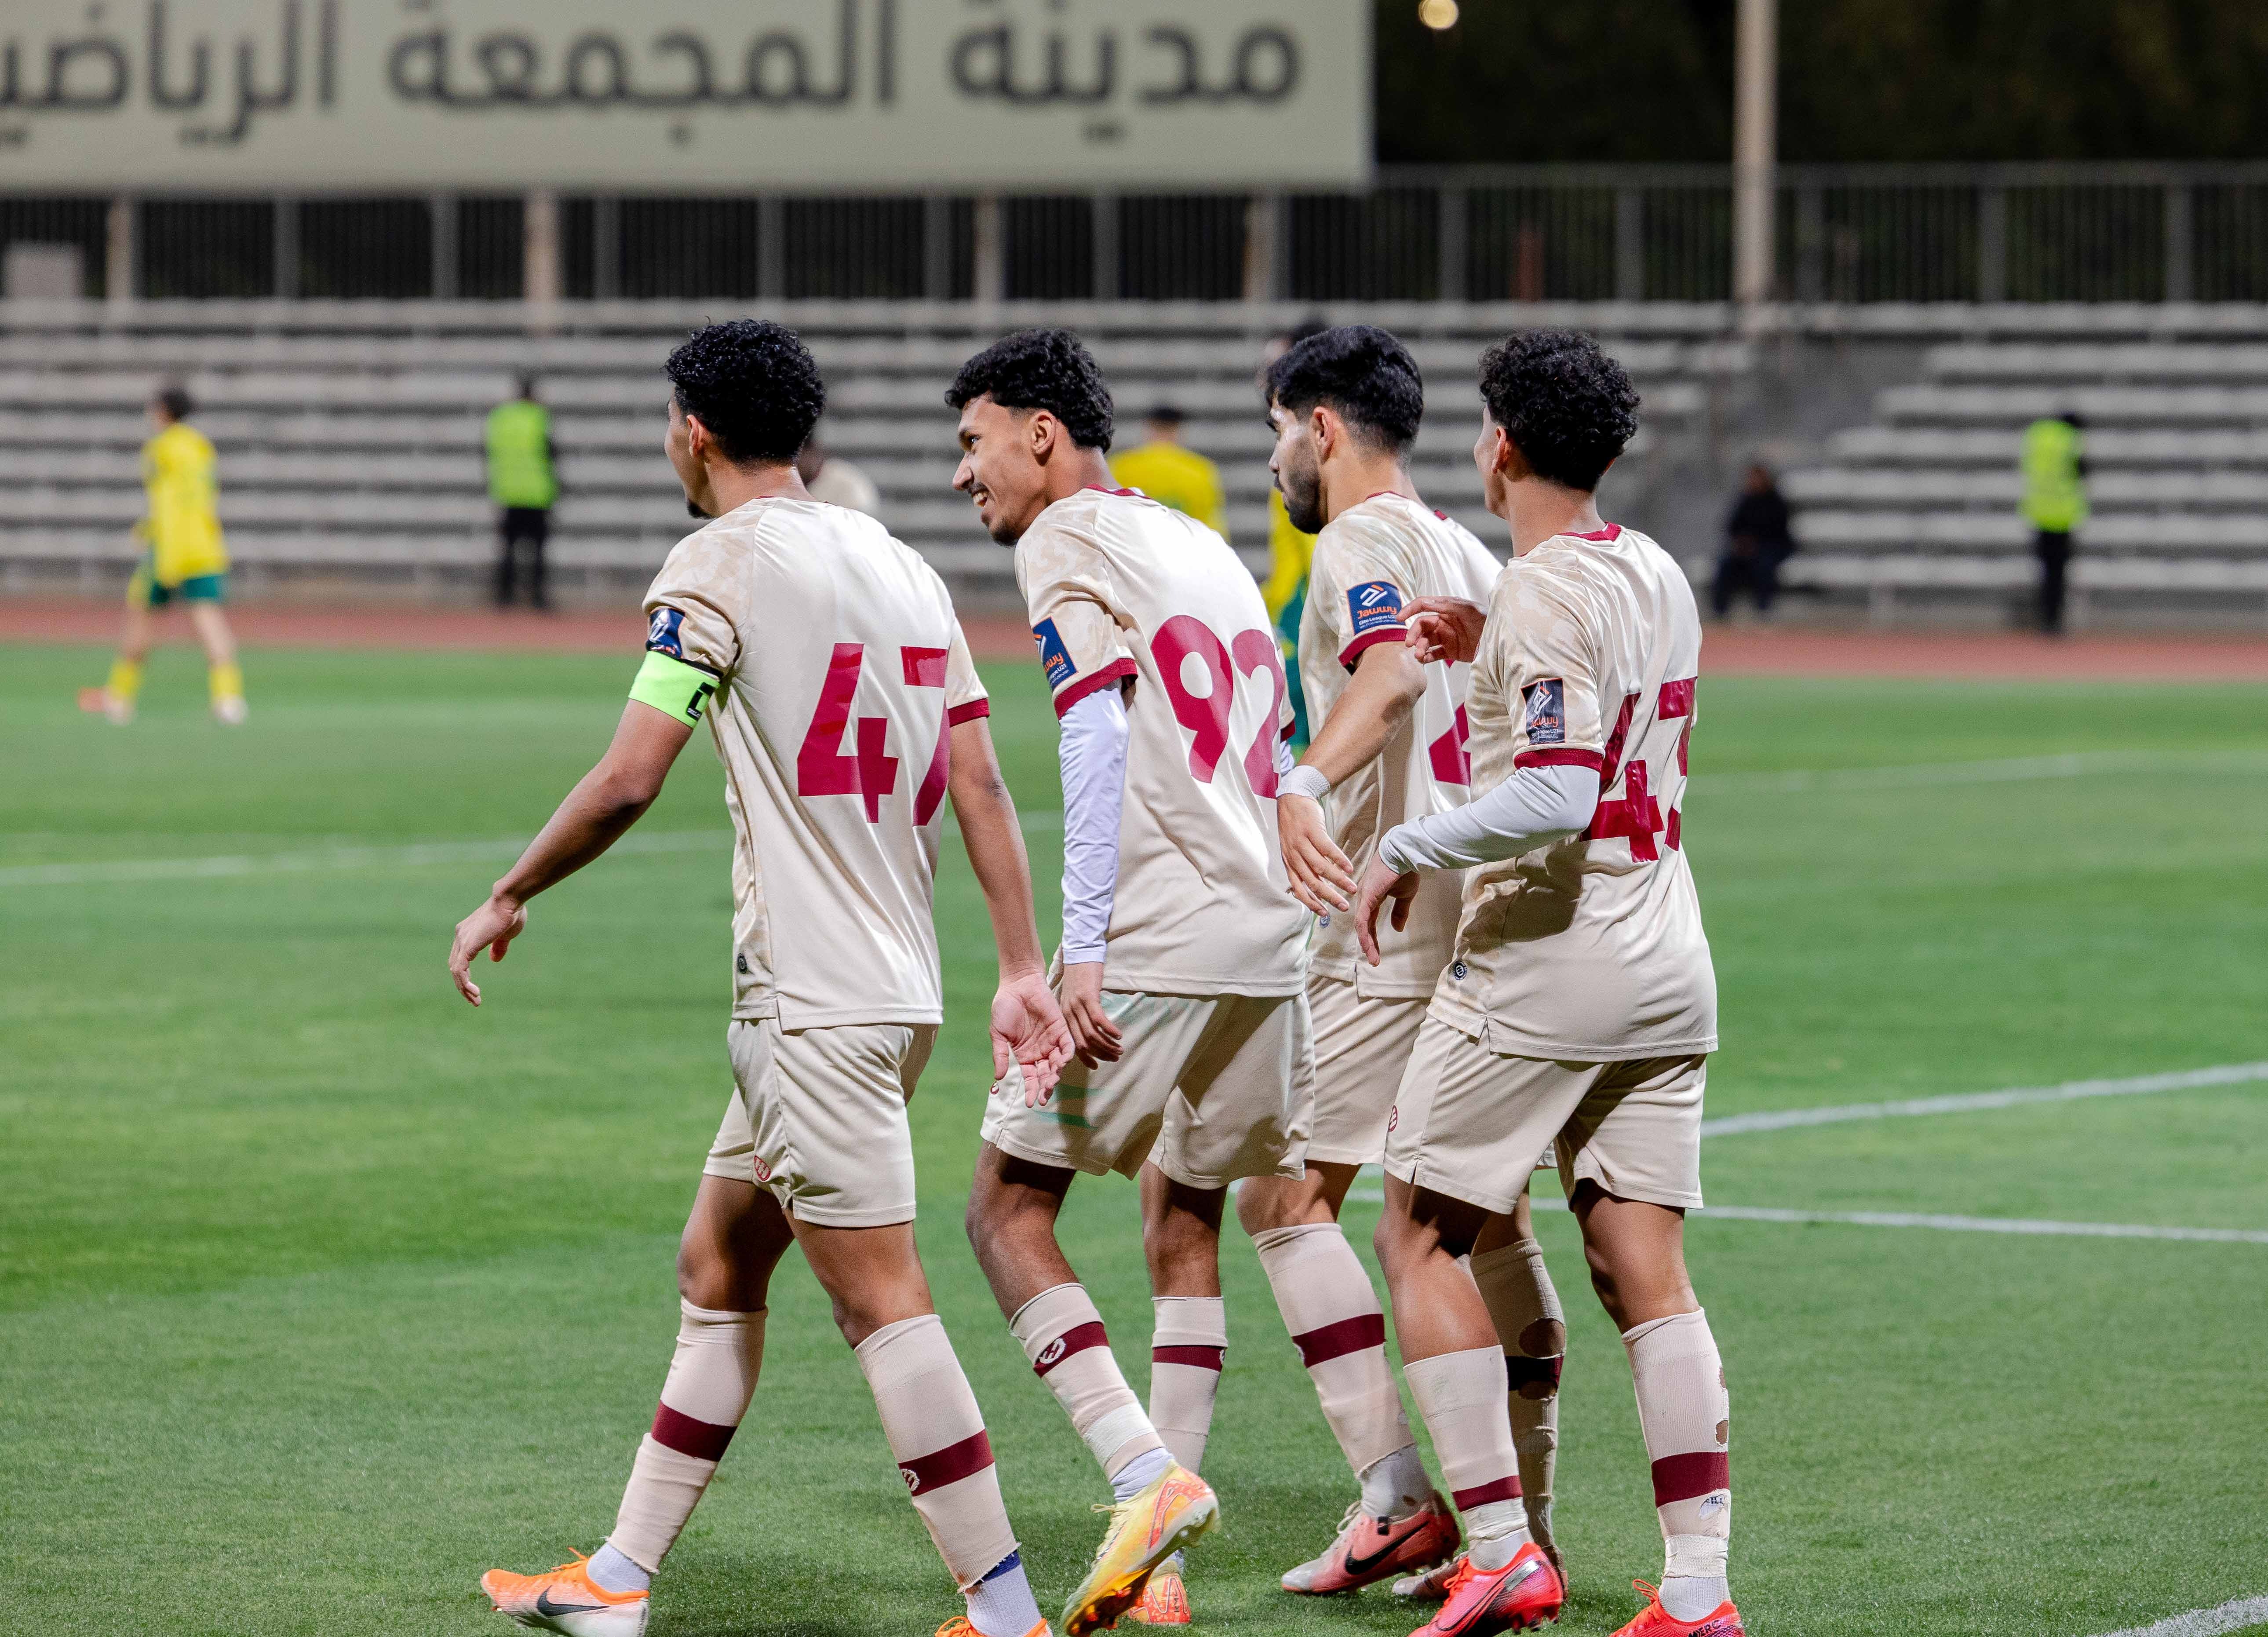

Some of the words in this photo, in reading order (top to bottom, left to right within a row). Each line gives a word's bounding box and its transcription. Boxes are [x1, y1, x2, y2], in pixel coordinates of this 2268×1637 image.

[0, 0, 339, 150] الرياضي
[384, 0, 899, 147] المجمعة
[946, 0, 1302, 143] مدينة
[796, 642, 951, 827] 47
[1151, 615, 1284, 799] 92
